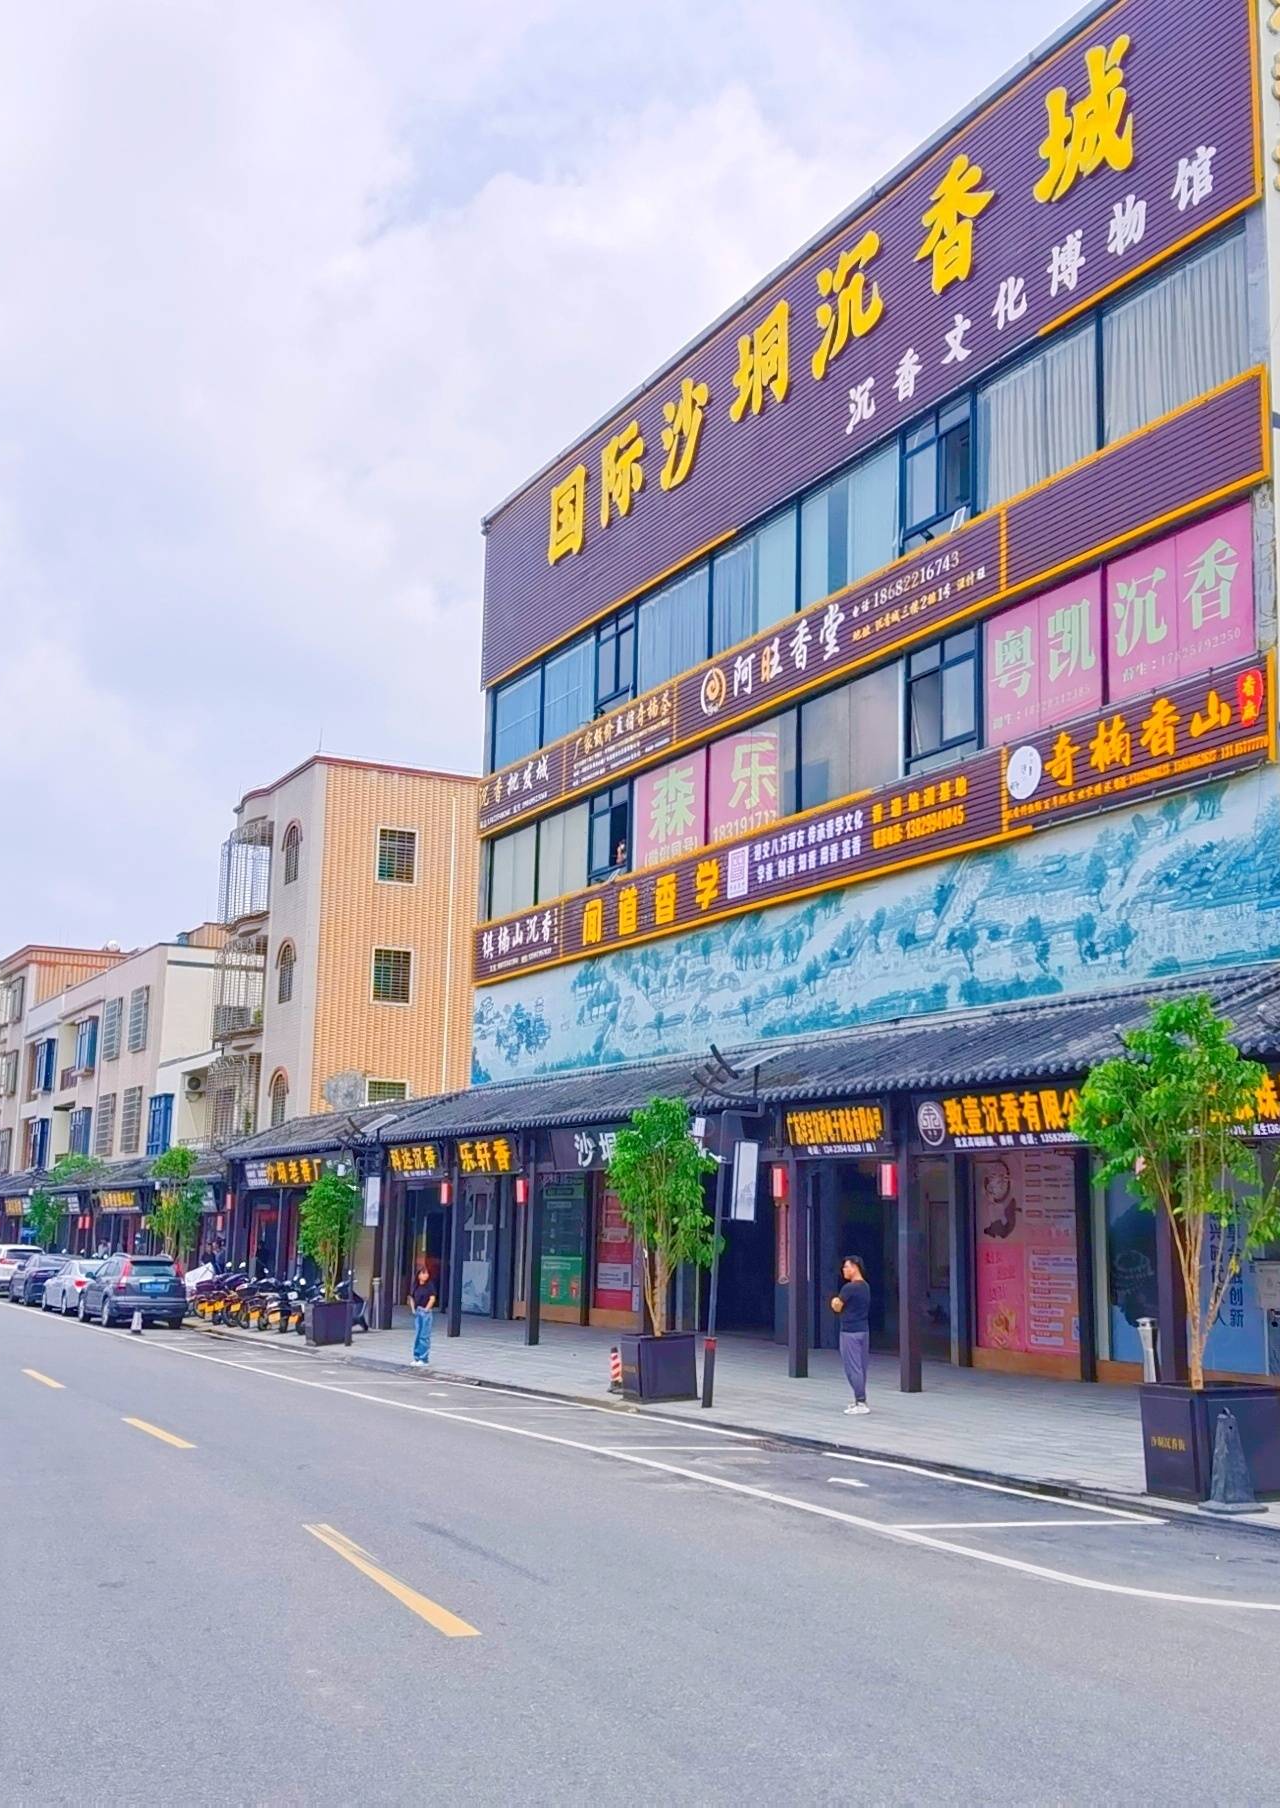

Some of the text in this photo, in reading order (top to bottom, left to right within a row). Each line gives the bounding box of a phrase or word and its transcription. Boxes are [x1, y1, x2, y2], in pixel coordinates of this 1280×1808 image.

[546, 34, 1136, 566] 国际沙垌沉香城
[844, 145, 1218, 434] 沉香文化博物馆
[873, 550, 961, 608] 18682216743
[991, 538, 1239, 699] 粤凯沉香
[732, 603, 846, 697] 阿旺香堂
[1044, 690, 1232, 787] 奇楠香山
[458, 1138, 512, 1173] 乐轩香
